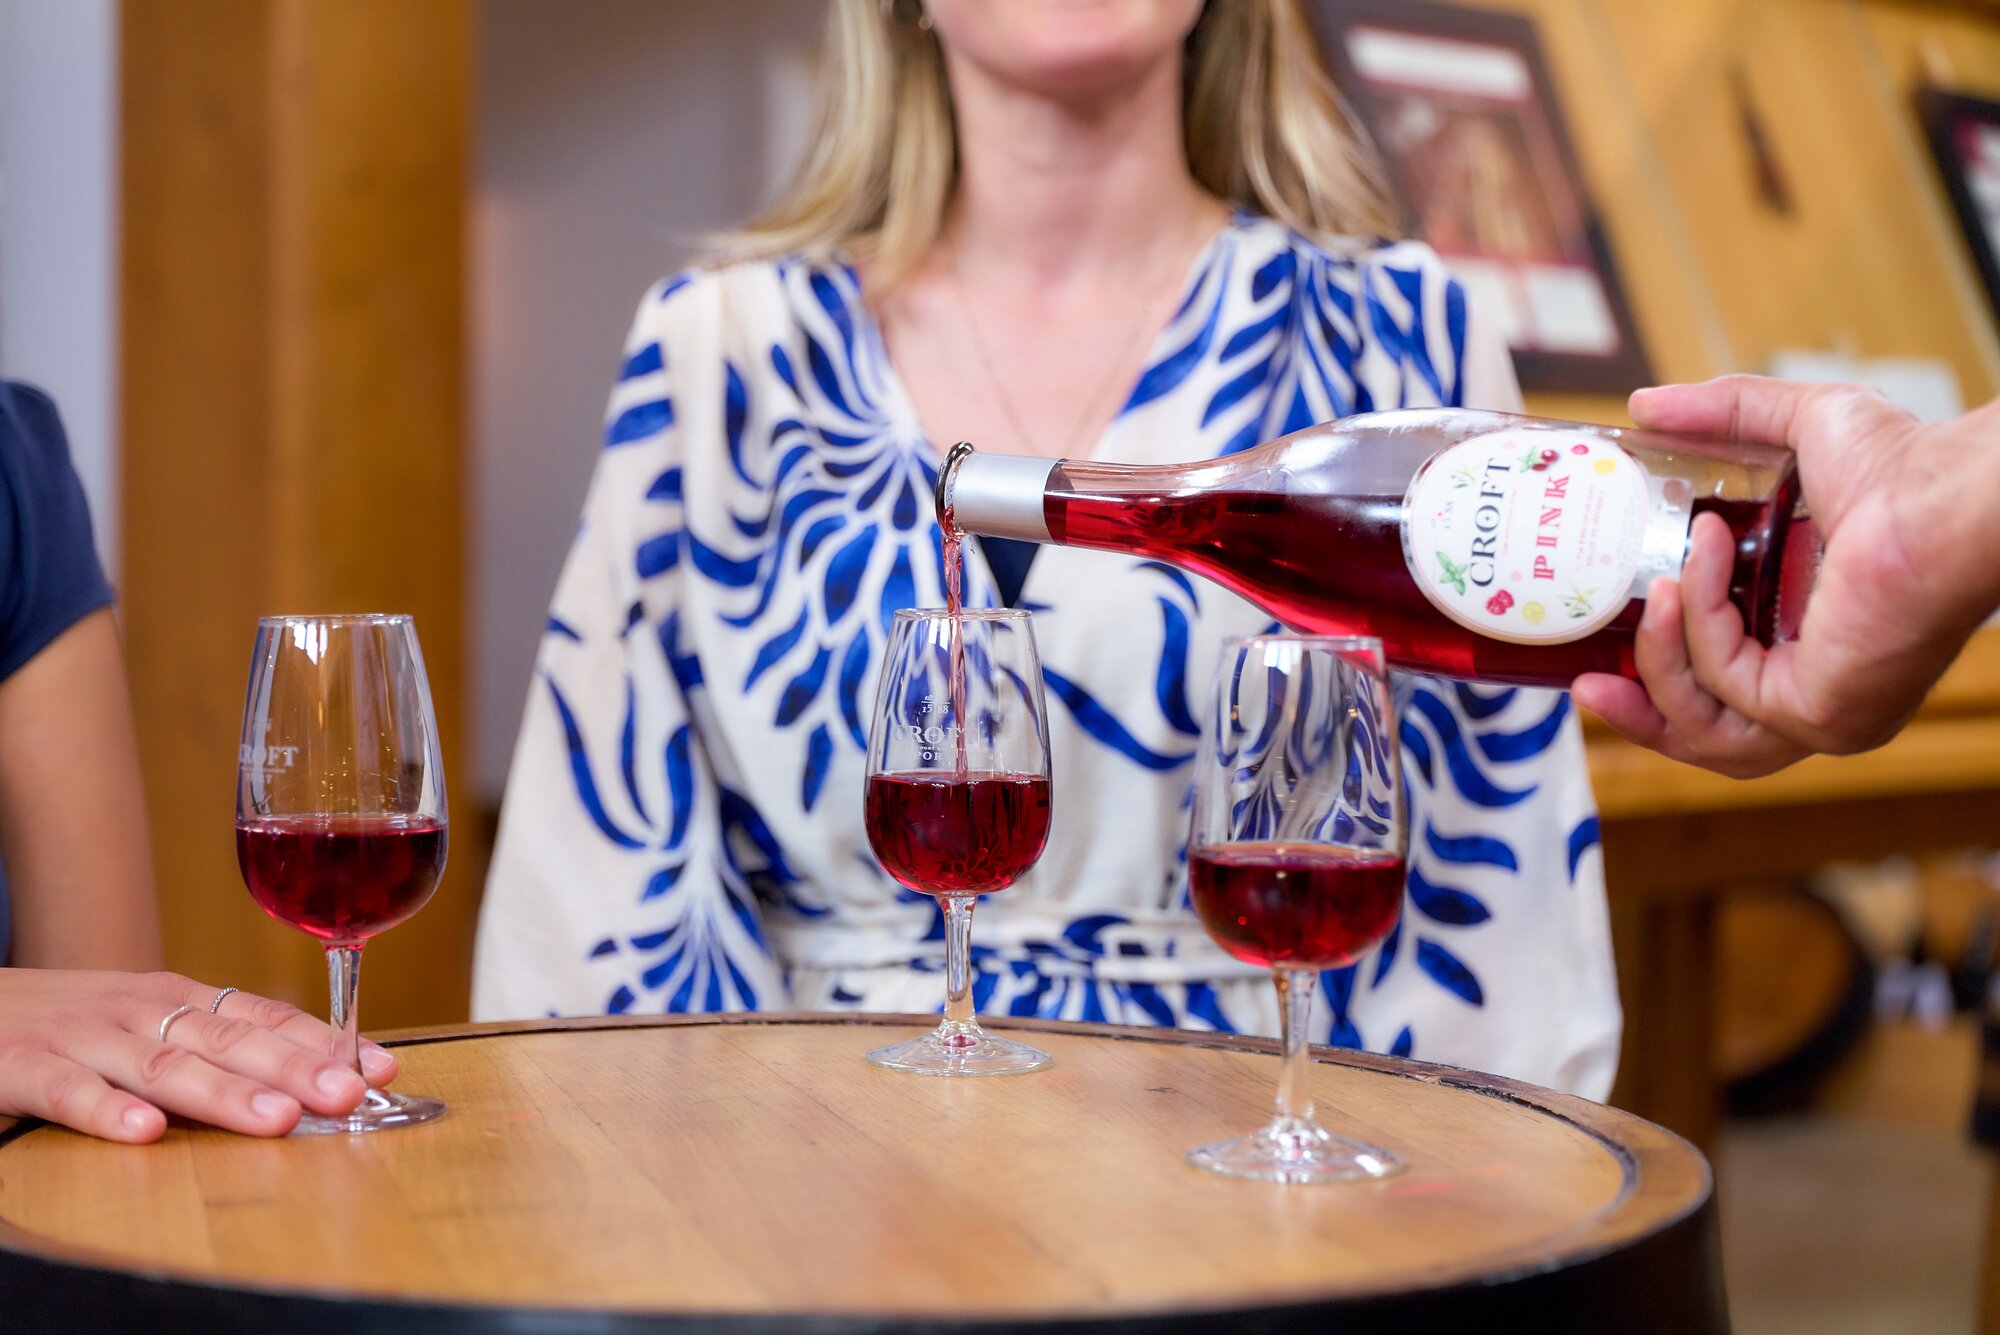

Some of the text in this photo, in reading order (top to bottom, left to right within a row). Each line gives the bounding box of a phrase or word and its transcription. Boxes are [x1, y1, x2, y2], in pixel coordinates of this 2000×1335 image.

[1470, 457, 1512, 587] CROFT
[1533, 474, 1570, 581] PINK
[894, 724, 972, 745] CROF
[922, 703, 949, 714] 1588
